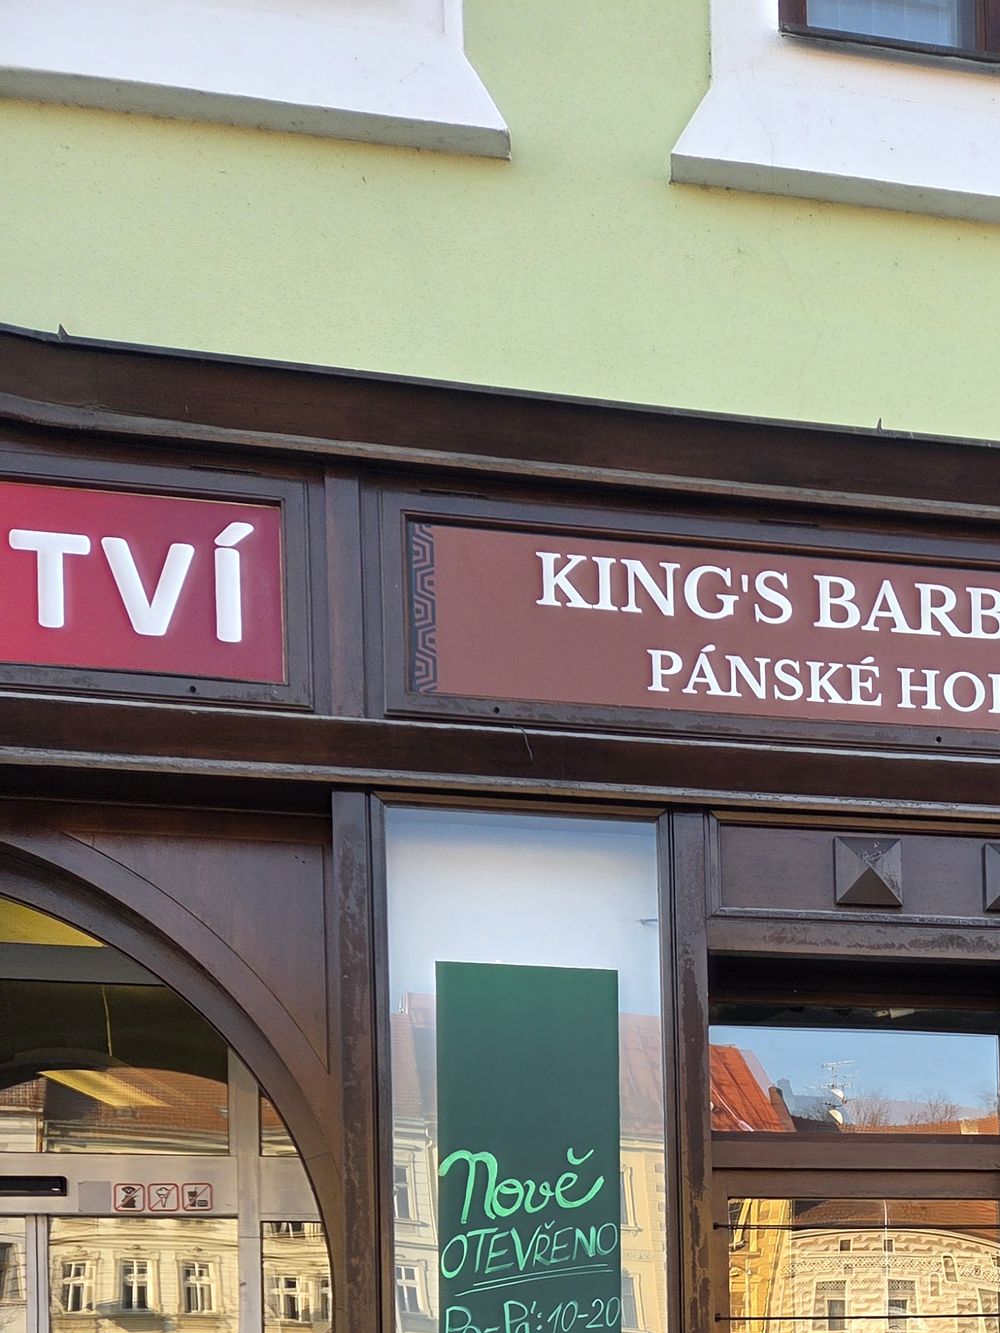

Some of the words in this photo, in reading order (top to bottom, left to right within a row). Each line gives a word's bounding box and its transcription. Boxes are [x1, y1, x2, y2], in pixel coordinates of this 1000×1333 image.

[9, 521, 254, 642] TVÍ
[535, 551, 793, 625] KING'S
[646, 644, 883, 707] PÁNSKÉ
[438, 1147, 605, 1224] Nově
[440, 1221, 618, 1279] OTEVŘENO
